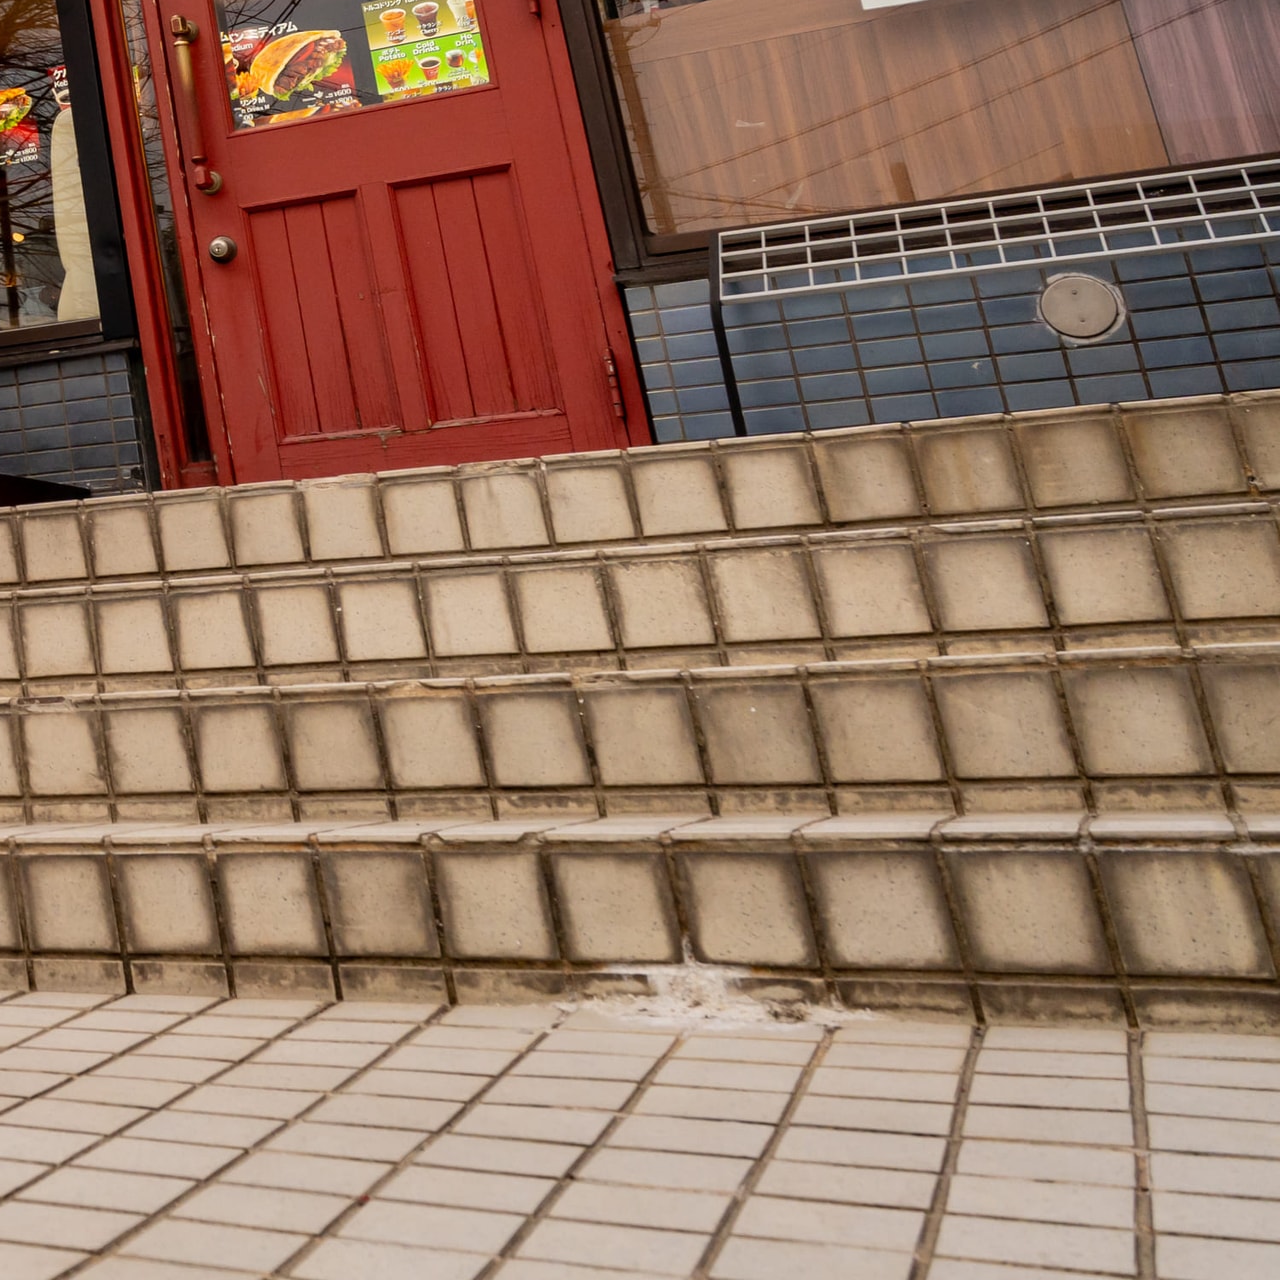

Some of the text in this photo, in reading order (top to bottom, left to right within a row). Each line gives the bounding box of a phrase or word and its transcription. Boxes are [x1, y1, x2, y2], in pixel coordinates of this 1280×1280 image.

[416, 41, 435, 49] Cold
[413, 46, 440, 55] Drinks
[379, 52, 406, 62] Potato
